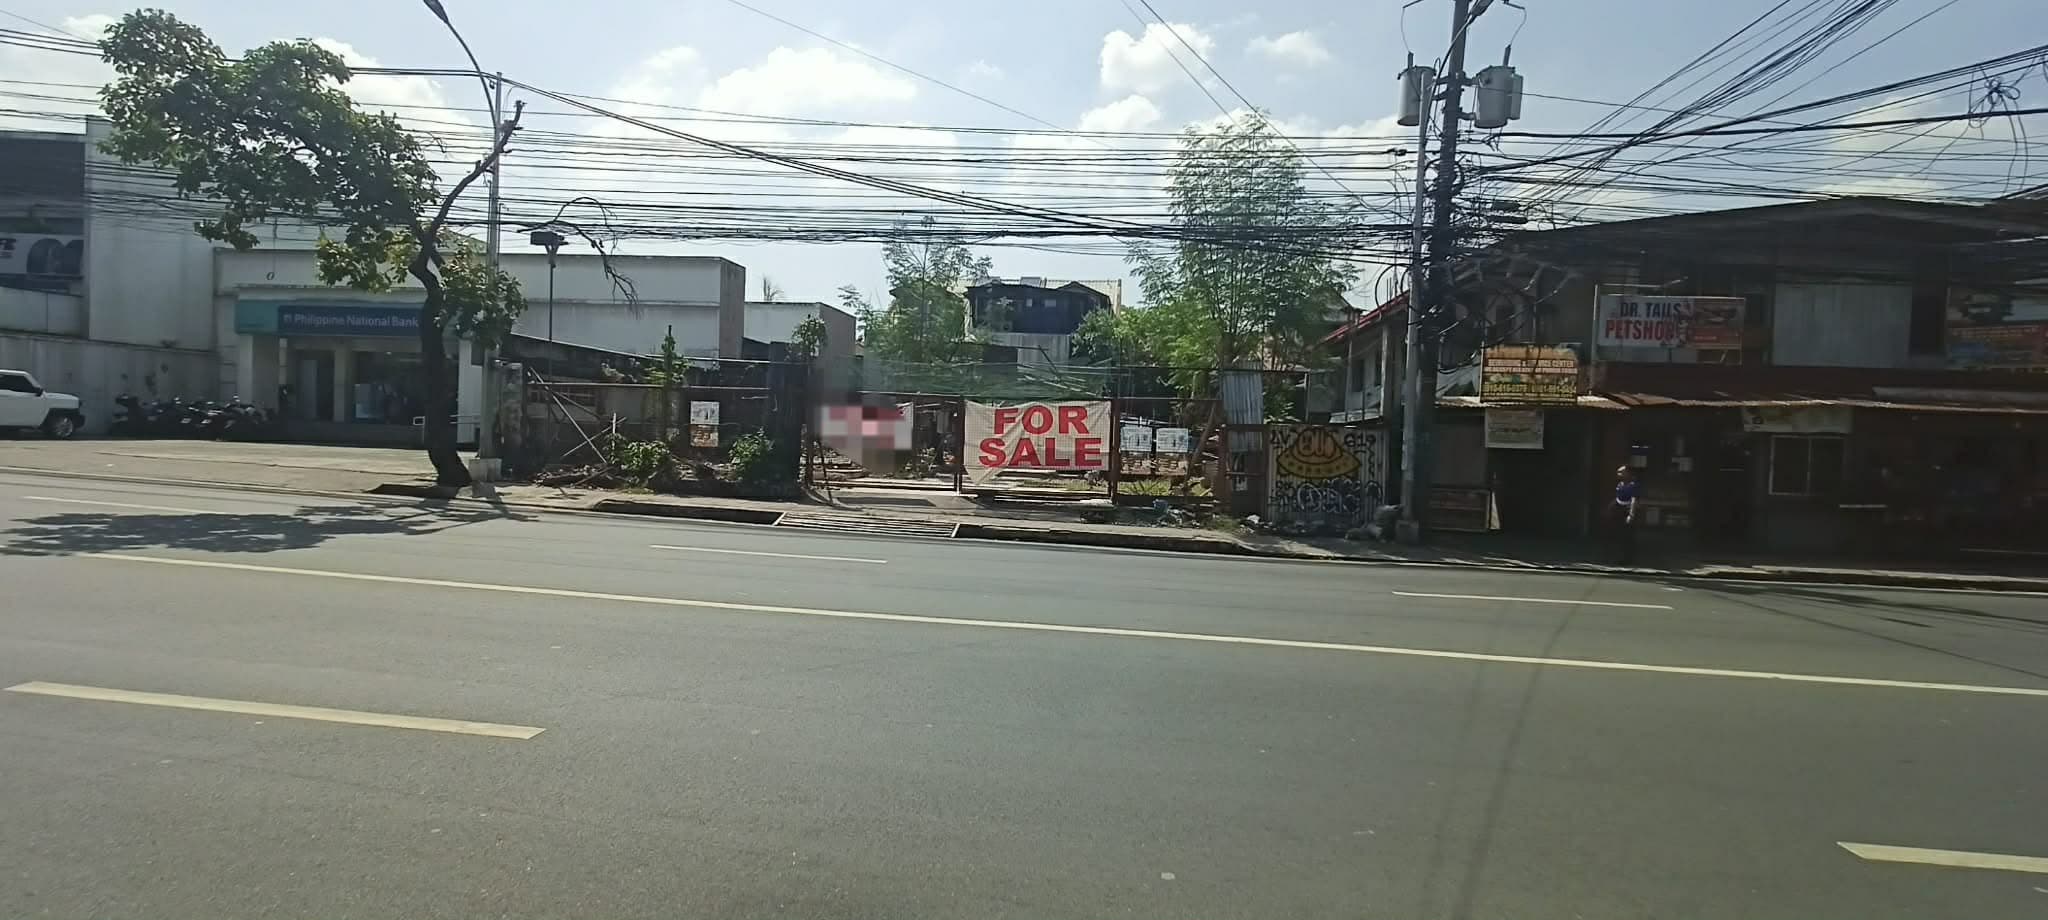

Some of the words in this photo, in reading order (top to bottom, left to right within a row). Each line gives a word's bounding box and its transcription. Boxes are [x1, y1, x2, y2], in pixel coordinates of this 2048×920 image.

[294, 313, 345, 328] Philippine
[346, 314, 391, 326] National
[393, 316, 419, 328] Bank
[1645, 302, 1681, 319] TAILS
[993, 405, 1090, 434] FOR
[978, 437, 1102, 467] SALE
